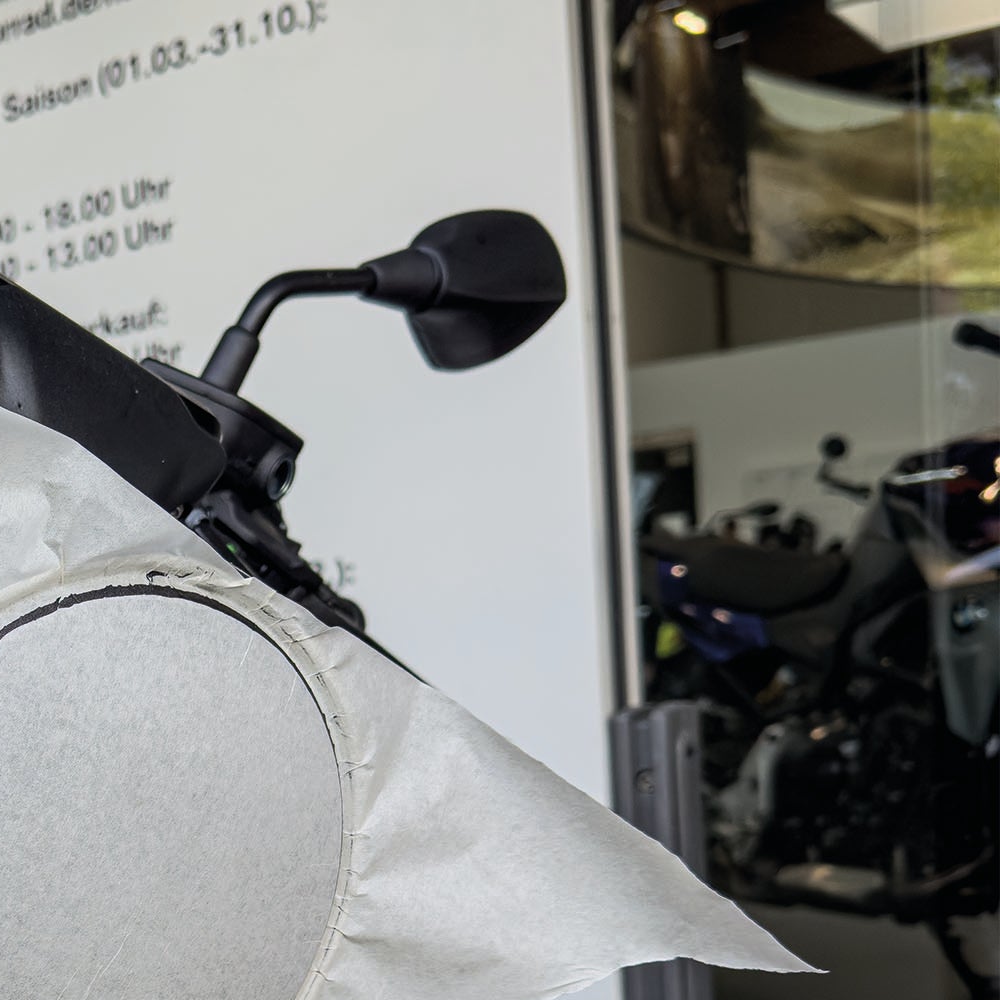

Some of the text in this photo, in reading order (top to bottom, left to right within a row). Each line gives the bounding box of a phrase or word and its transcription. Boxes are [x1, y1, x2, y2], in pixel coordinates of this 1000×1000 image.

[1, 74, 94, 122] Saison
[120, 177, 172, 210] Uhr
[123, 217, 175, 251] Uhr
